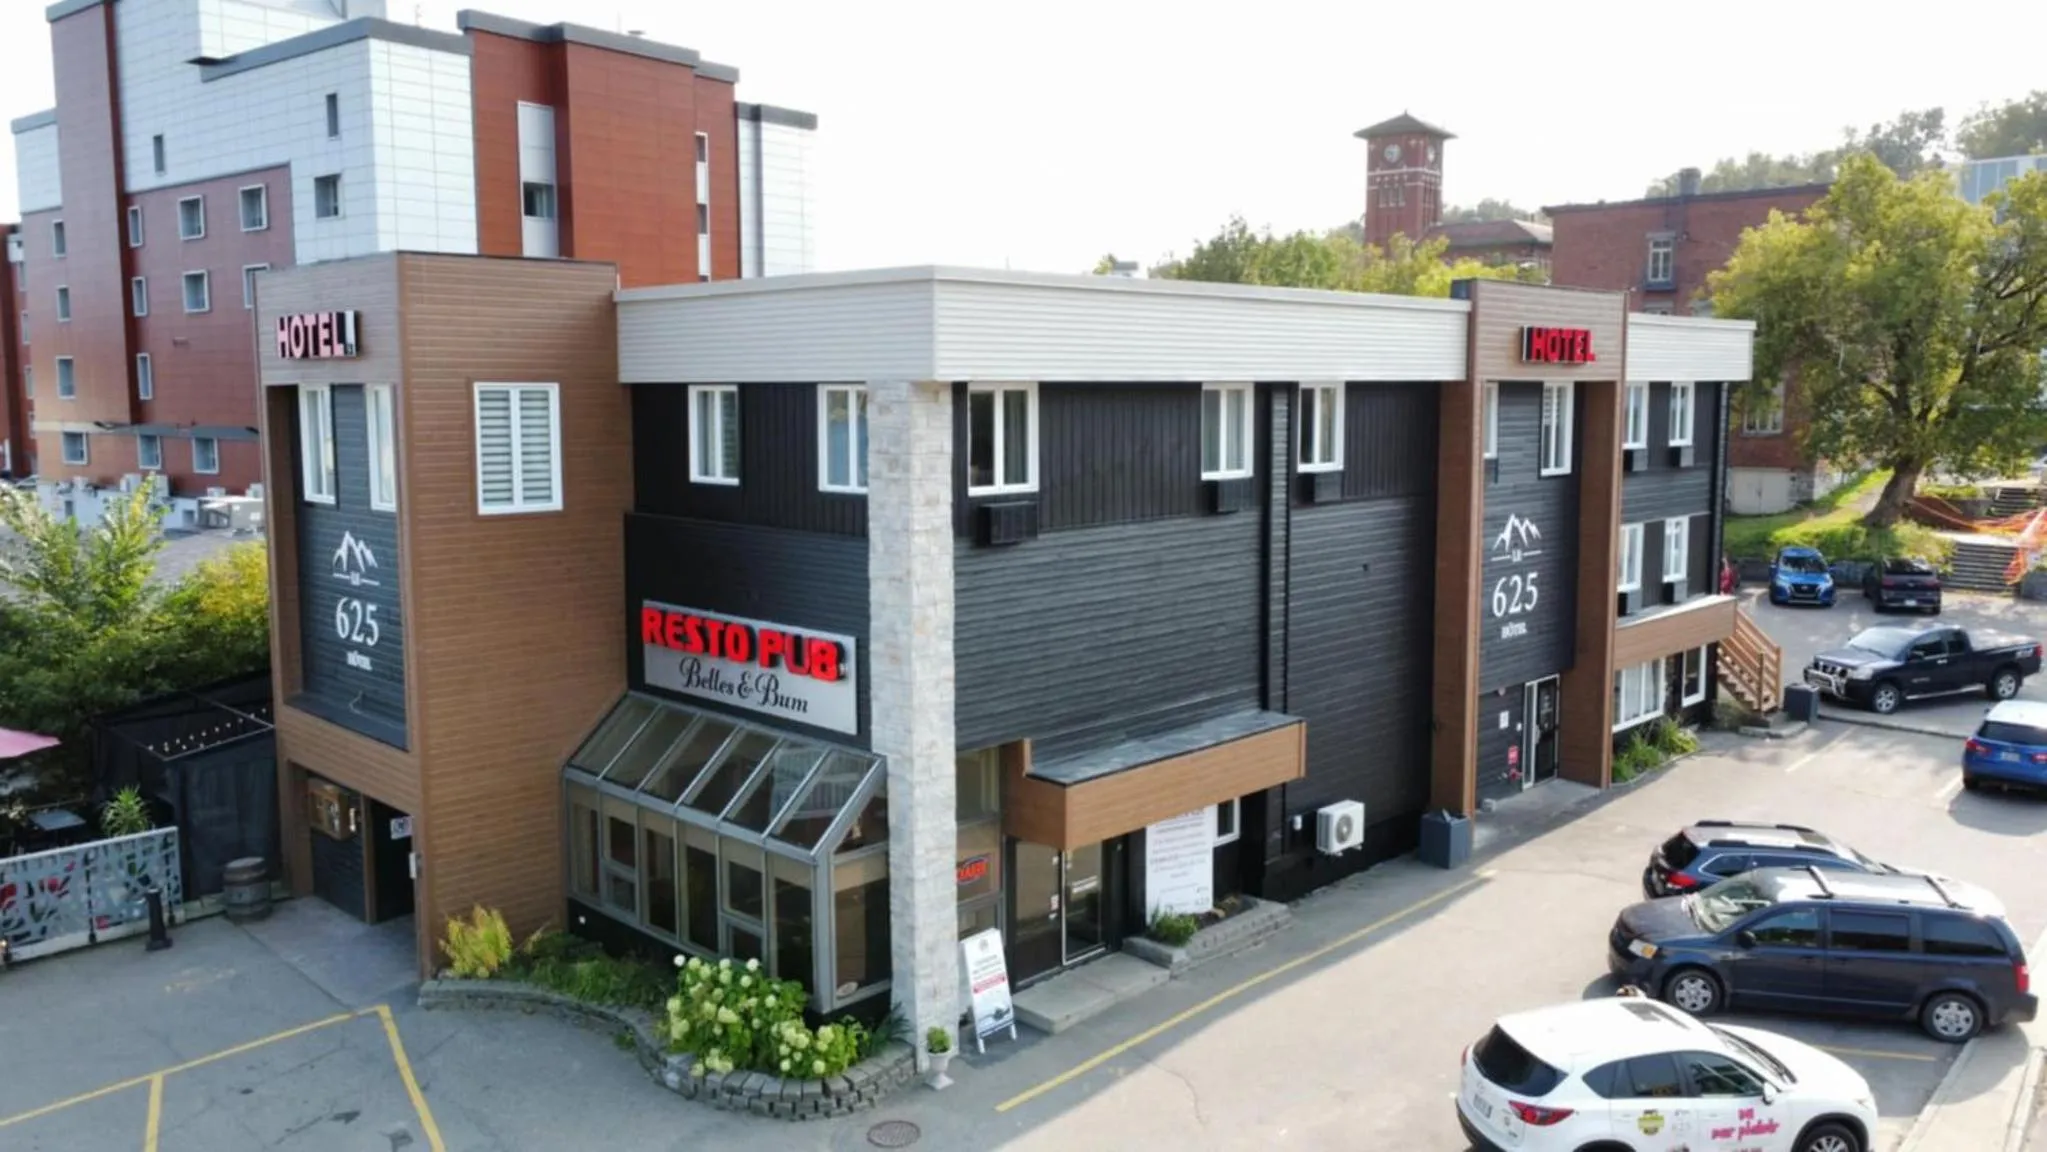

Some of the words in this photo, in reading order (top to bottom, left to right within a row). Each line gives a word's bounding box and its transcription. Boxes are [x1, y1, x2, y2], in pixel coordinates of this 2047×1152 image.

[277, 311, 345, 359] HOTEL
[1531, 326, 1596, 364] HOTEL
[1493, 571, 1538, 618] 625
[336, 596, 379, 646] 625
[642, 606, 750, 664] RESTO
[757, 627, 838, 683] PUB
[679, 656, 735, 696] Belles
[737, 670, 754, 699] &
[755, 672, 808, 713] Bum
